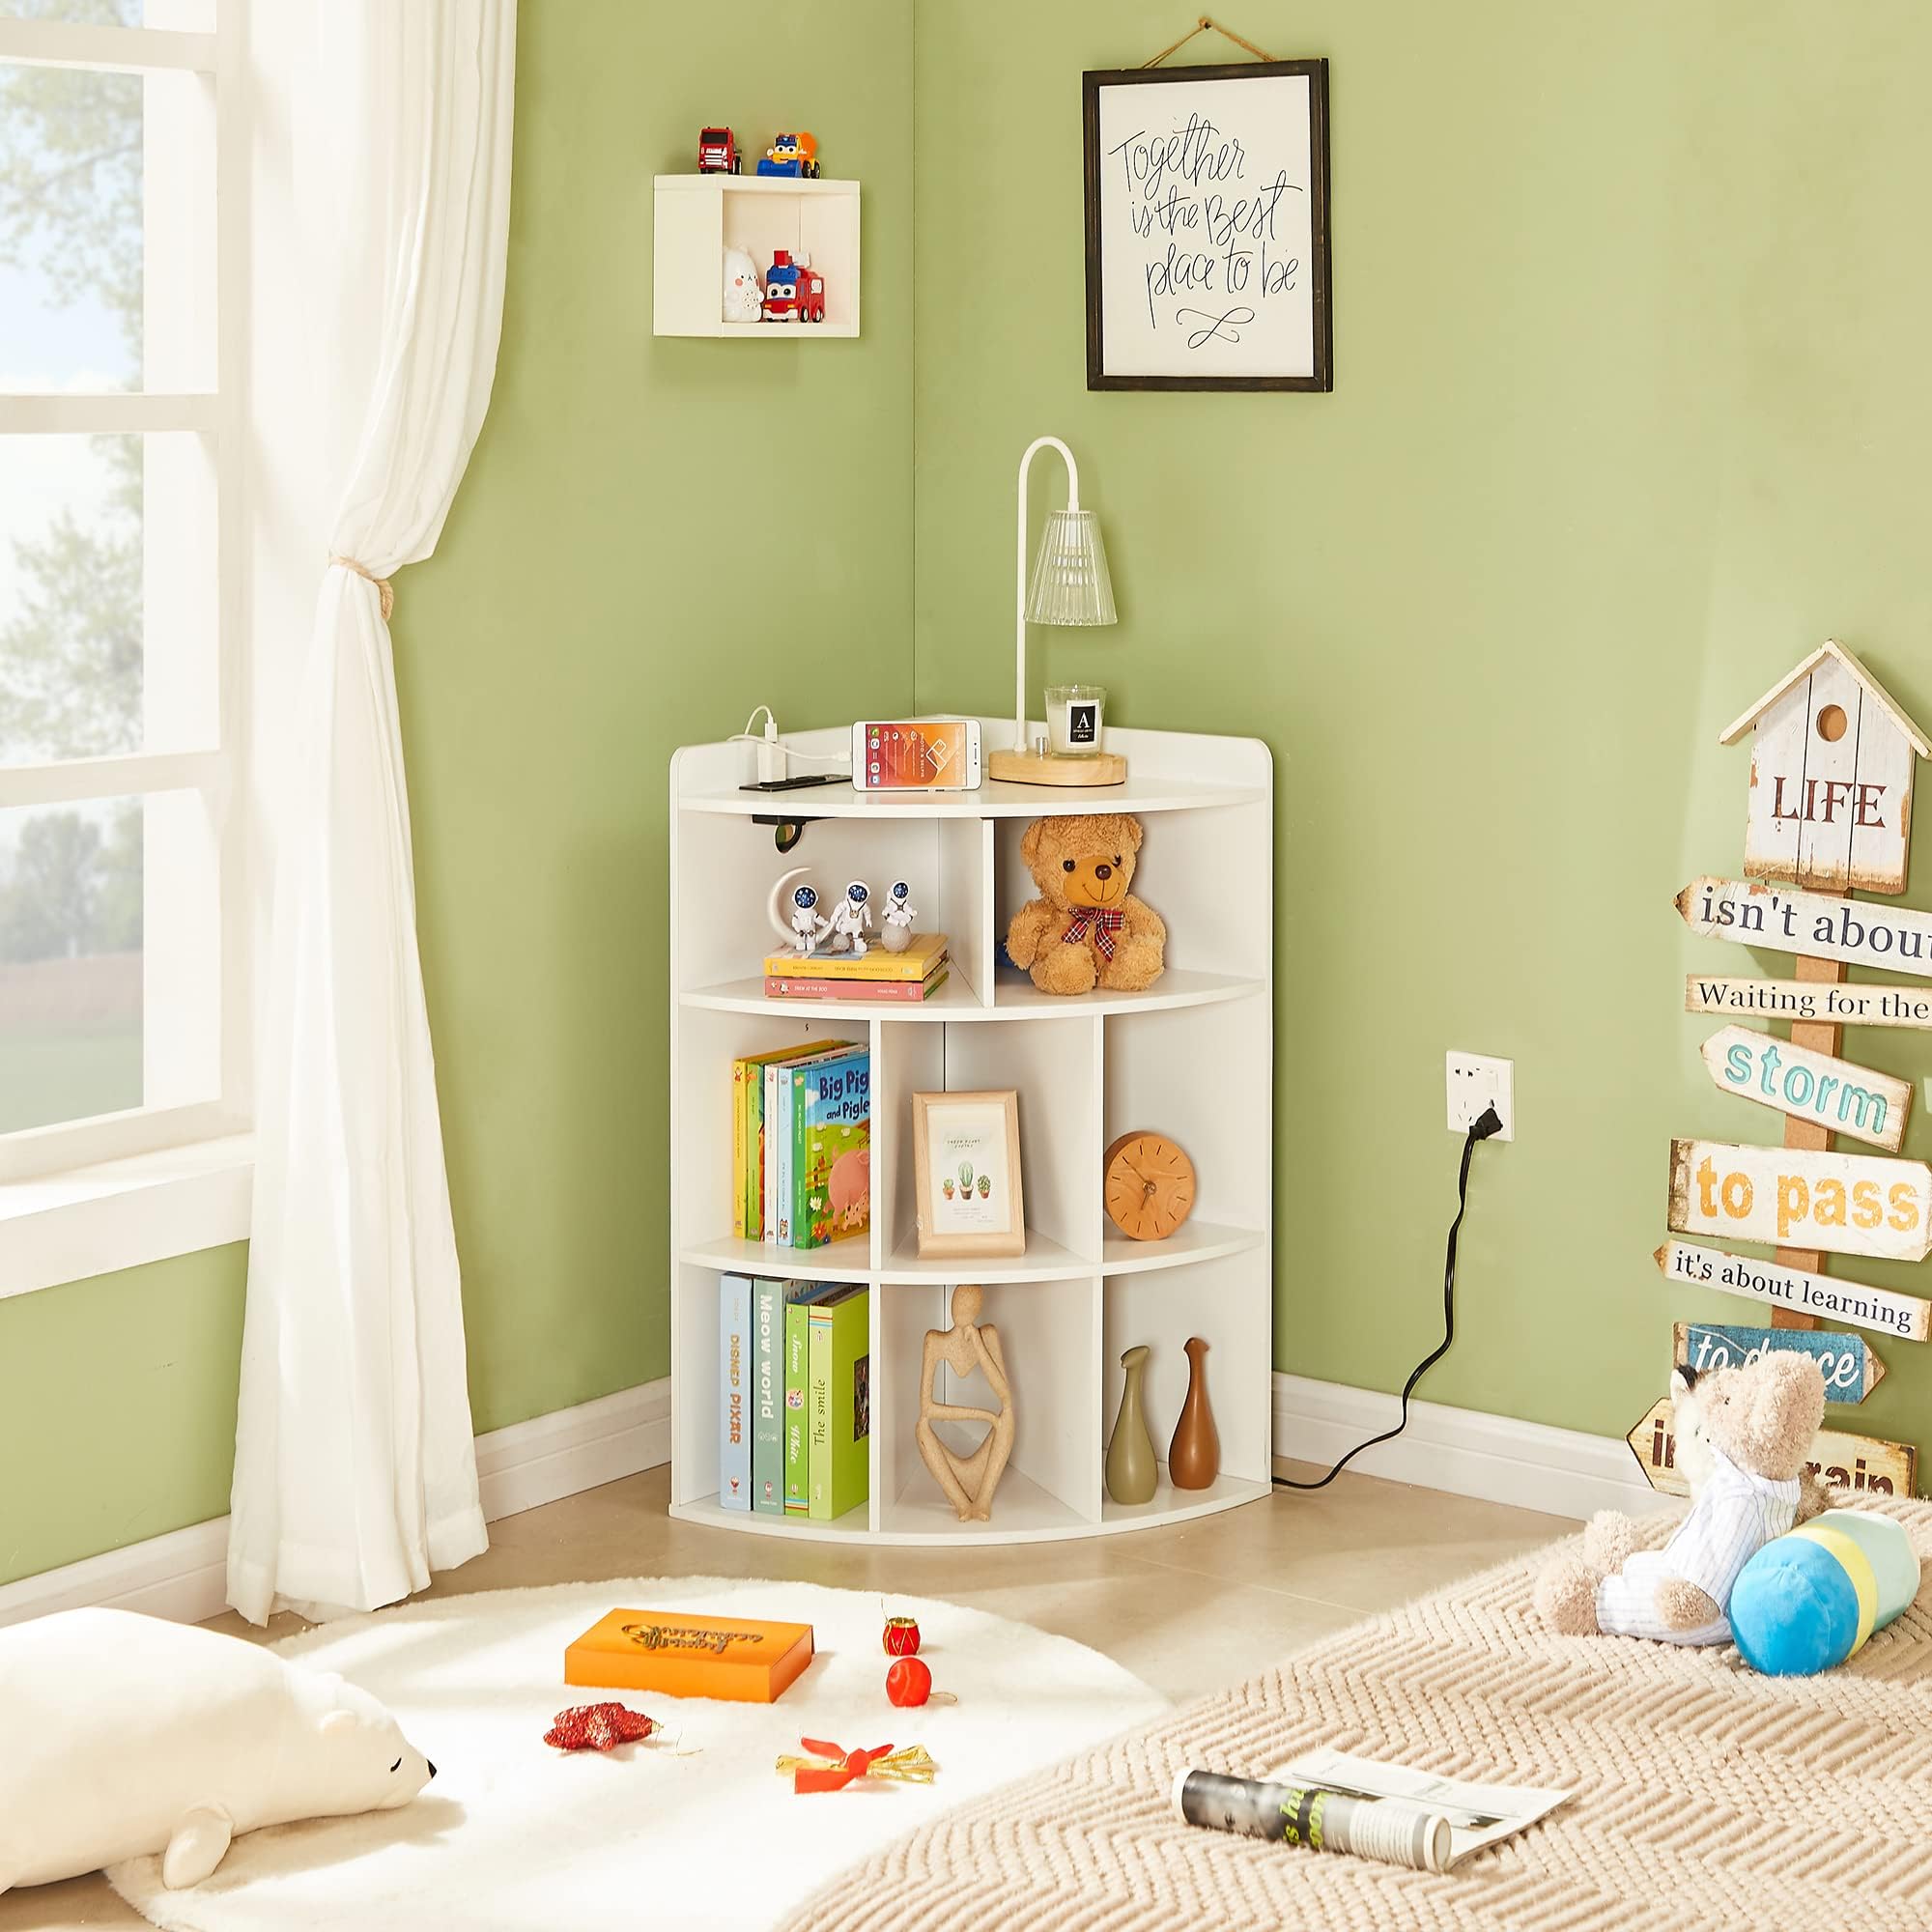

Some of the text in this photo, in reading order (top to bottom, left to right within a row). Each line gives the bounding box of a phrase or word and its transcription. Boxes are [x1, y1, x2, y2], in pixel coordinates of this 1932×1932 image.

[1108, 112, 1245, 200] Together
[1131, 170, 1303, 246] is the Best
[1146, 239, 1299, 329] place to be
[1076, 711, 1091, 729] A
[1771, 777, 1888, 829] LIFE
[1700, 886, 1932, 960] isn't abou
[1697, 982, 1929, 1019] Waiting for the
[819, 1069, 869, 1101] Big Pig
[826, 1104, 841, 1120] and
[1724, 1043, 1889, 1135] storm
[1696, 1155, 1919, 1238] to pass
[759, 1294, 773, 1352] Meow
[1675, 1250, 1913, 1333] it's about learning
[760, 1360, 774, 1419] world
[1743, 1337, 1860, 1388] dce
[729, 1392, 742, 1444] PIXAR
[789, 1334, 803, 1464] Snow White
[813, 1378, 826, 1445] The smile
